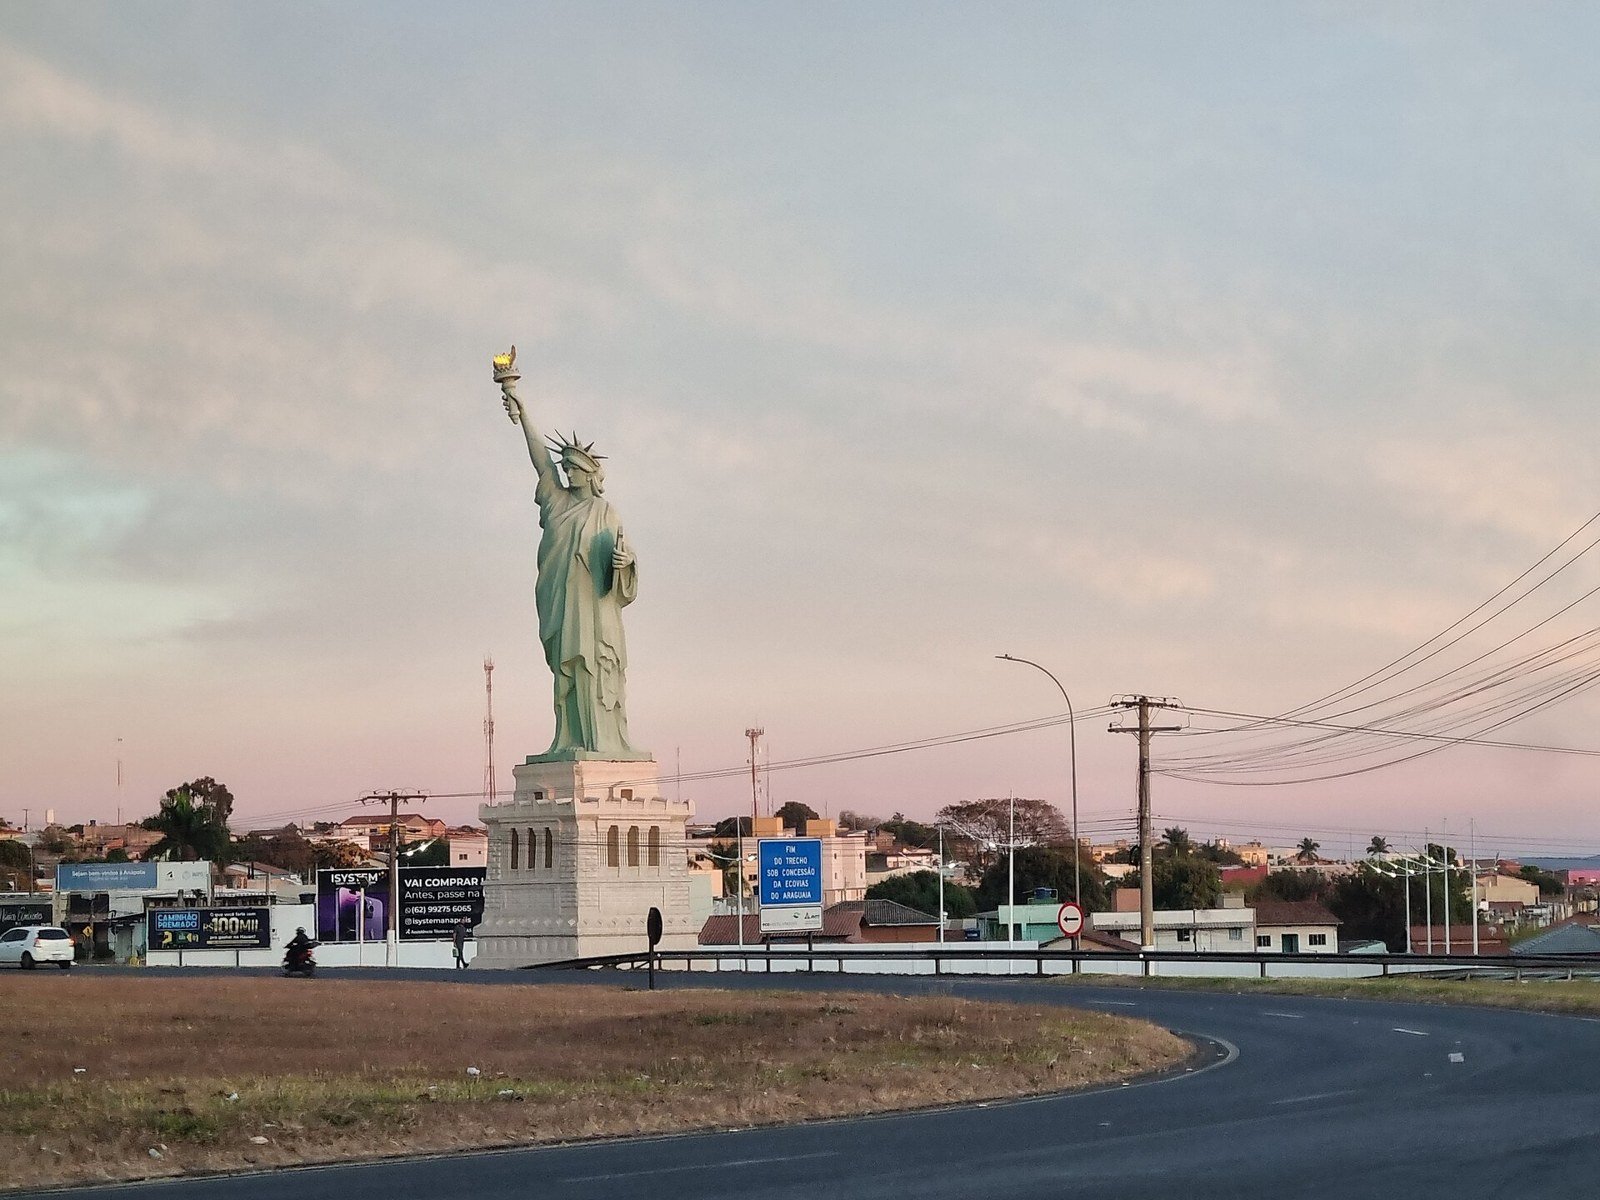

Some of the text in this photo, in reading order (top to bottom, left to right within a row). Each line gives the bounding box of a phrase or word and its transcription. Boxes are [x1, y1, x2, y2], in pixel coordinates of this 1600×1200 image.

[774, 857, 808, 865] DO TRECHO
[767, 866, 815, 877] SOB CONCESSÃO
[404, 879, 422, 888] VAI
[425, 877, 479, 887] COMPRAR
[785, 880, 809, 888] ECOVIAS
[404, 891, 435, 899] Antes,
[438, 890, 465, 900] passe
[467, 890, 480, 898] na
[771, 891, 811, 900] DO ARAGUAIA
[411, 905, 426, 914] (62)
[427, 905, 451, 913] 99275
[157, 912, 198, 921] CAMINHÃO
